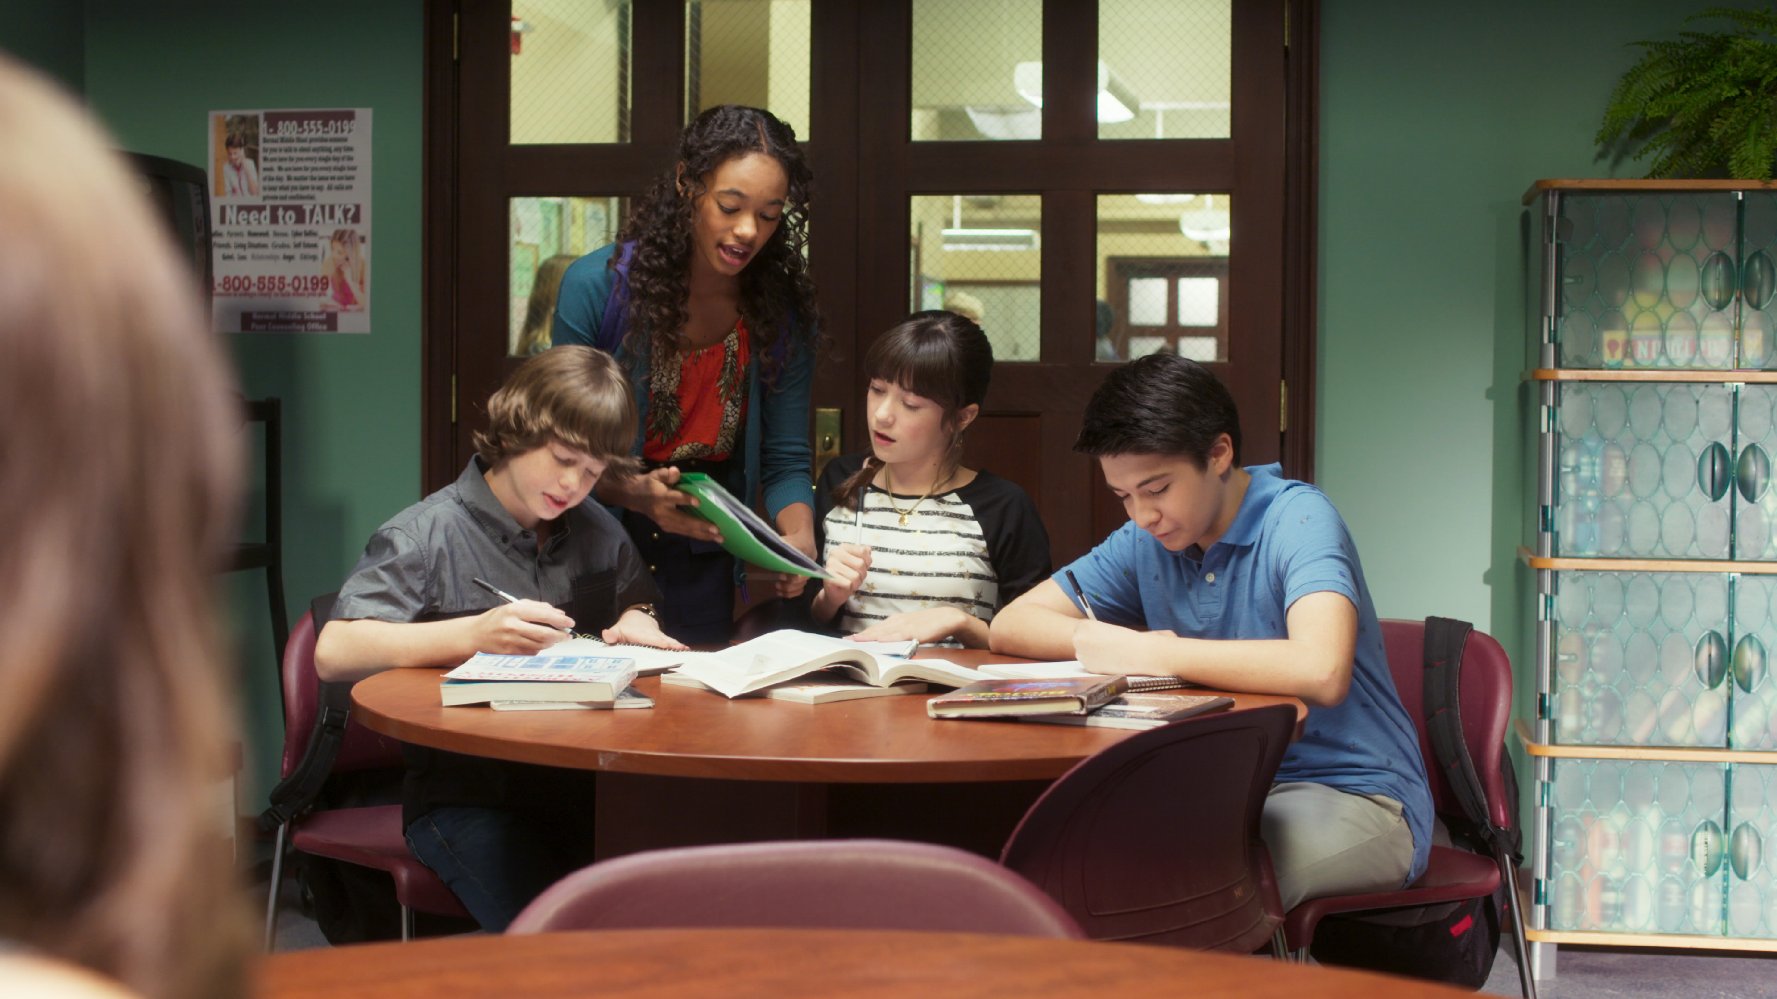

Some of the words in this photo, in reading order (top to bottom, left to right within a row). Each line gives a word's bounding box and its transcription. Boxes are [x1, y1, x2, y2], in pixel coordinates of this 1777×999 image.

[225, 204, 270, 224] Need
[278, 206, 296, 224] to
[302, 203, 356, 224] TALK?
